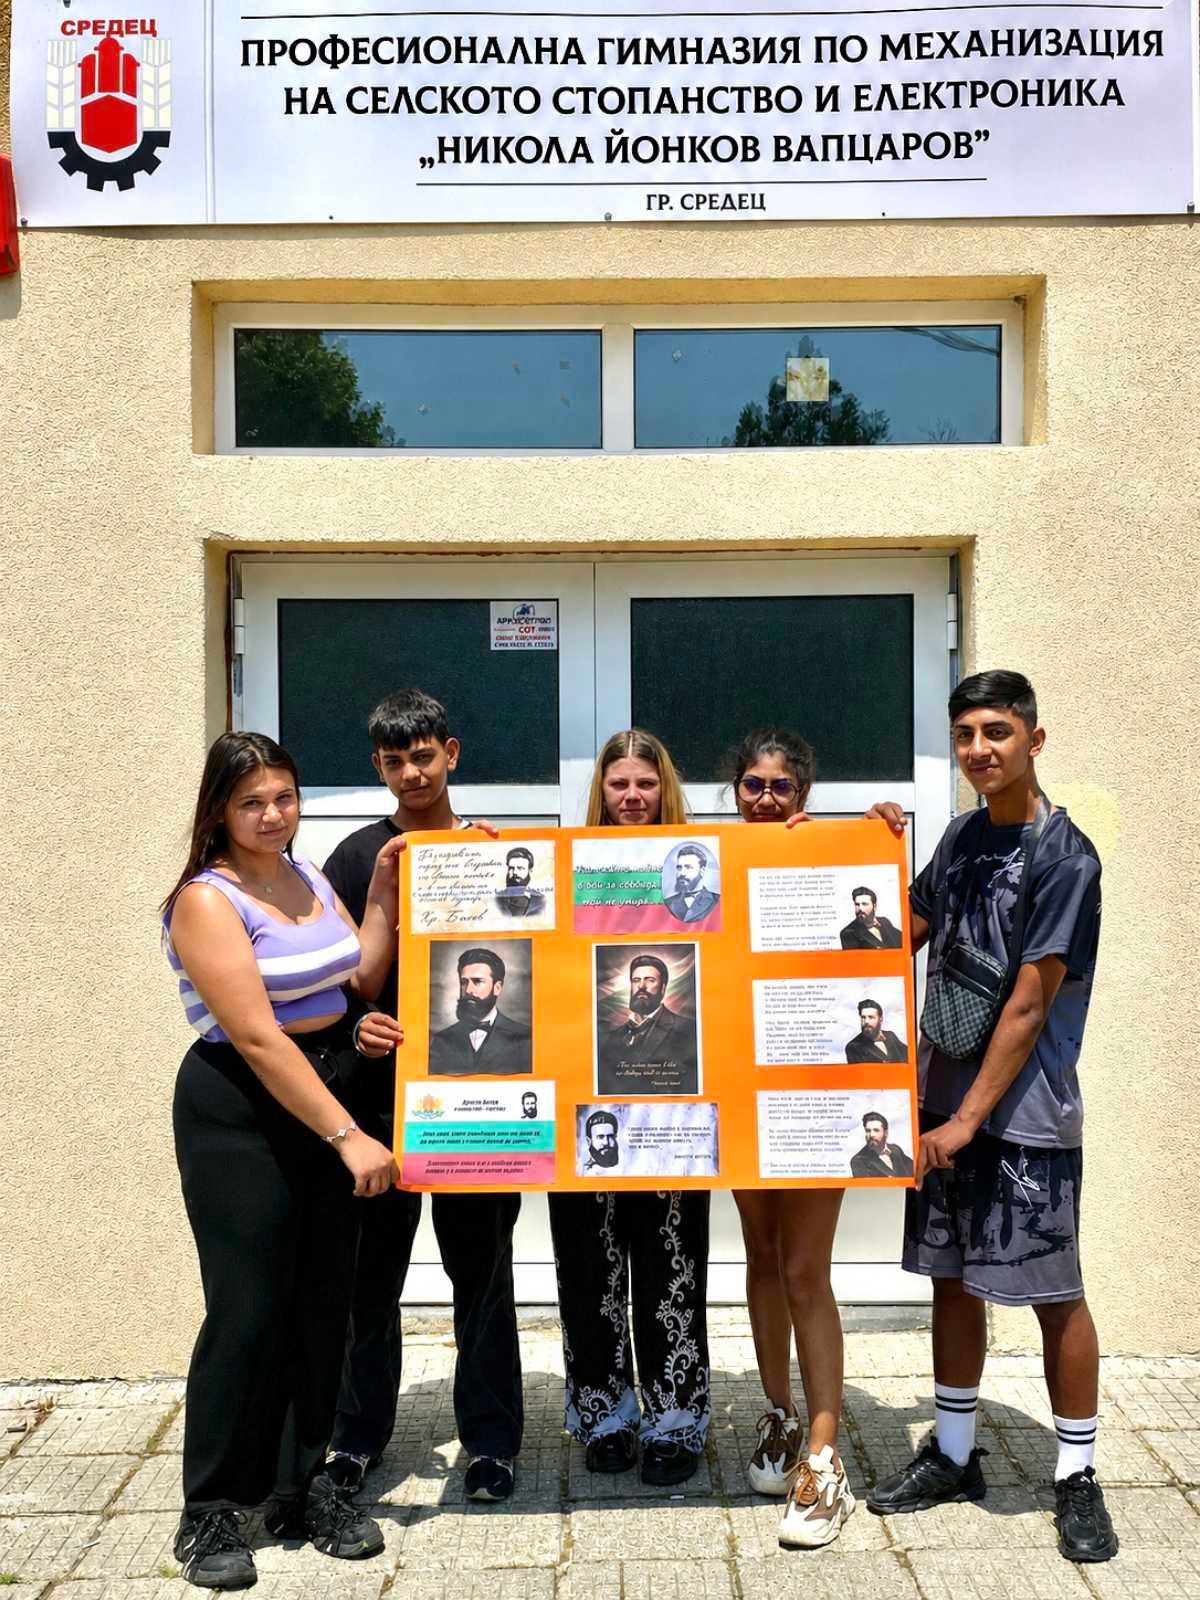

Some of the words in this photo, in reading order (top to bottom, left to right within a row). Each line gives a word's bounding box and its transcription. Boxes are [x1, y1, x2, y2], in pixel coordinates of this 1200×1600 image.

[60, 18, 158, 38] СРЕДЕЦ
[240, 33, 587, 70] ПРОФЕСИОНАЛНА
[597, 36, 801, 65] ГИМНАЗИЯ
[814, 35, 868, 64] ПО
[879, 28, 1164, 62] МЕХАНИЗАЦИЯ
[284, 86, 337, 115] НА
[345, 85, 541, 115] СЕЛСКОТО
[552, 85, 803, 115] СТОПАНСТВО
[815, 85, 840, 113] И
[853, 78, 1126, 112] ЕЛЕКТРОНИКА
[419, 135, 594, 169] „НИКОЛА
[604, 128, 761, 164] ЙОНКОВ
[772, 129, 990, 165] ВАПЦАРОВ”
[646, 194, 674, 211] ГР.
[680, 193, 766, 211] СРЕДЕЦ
